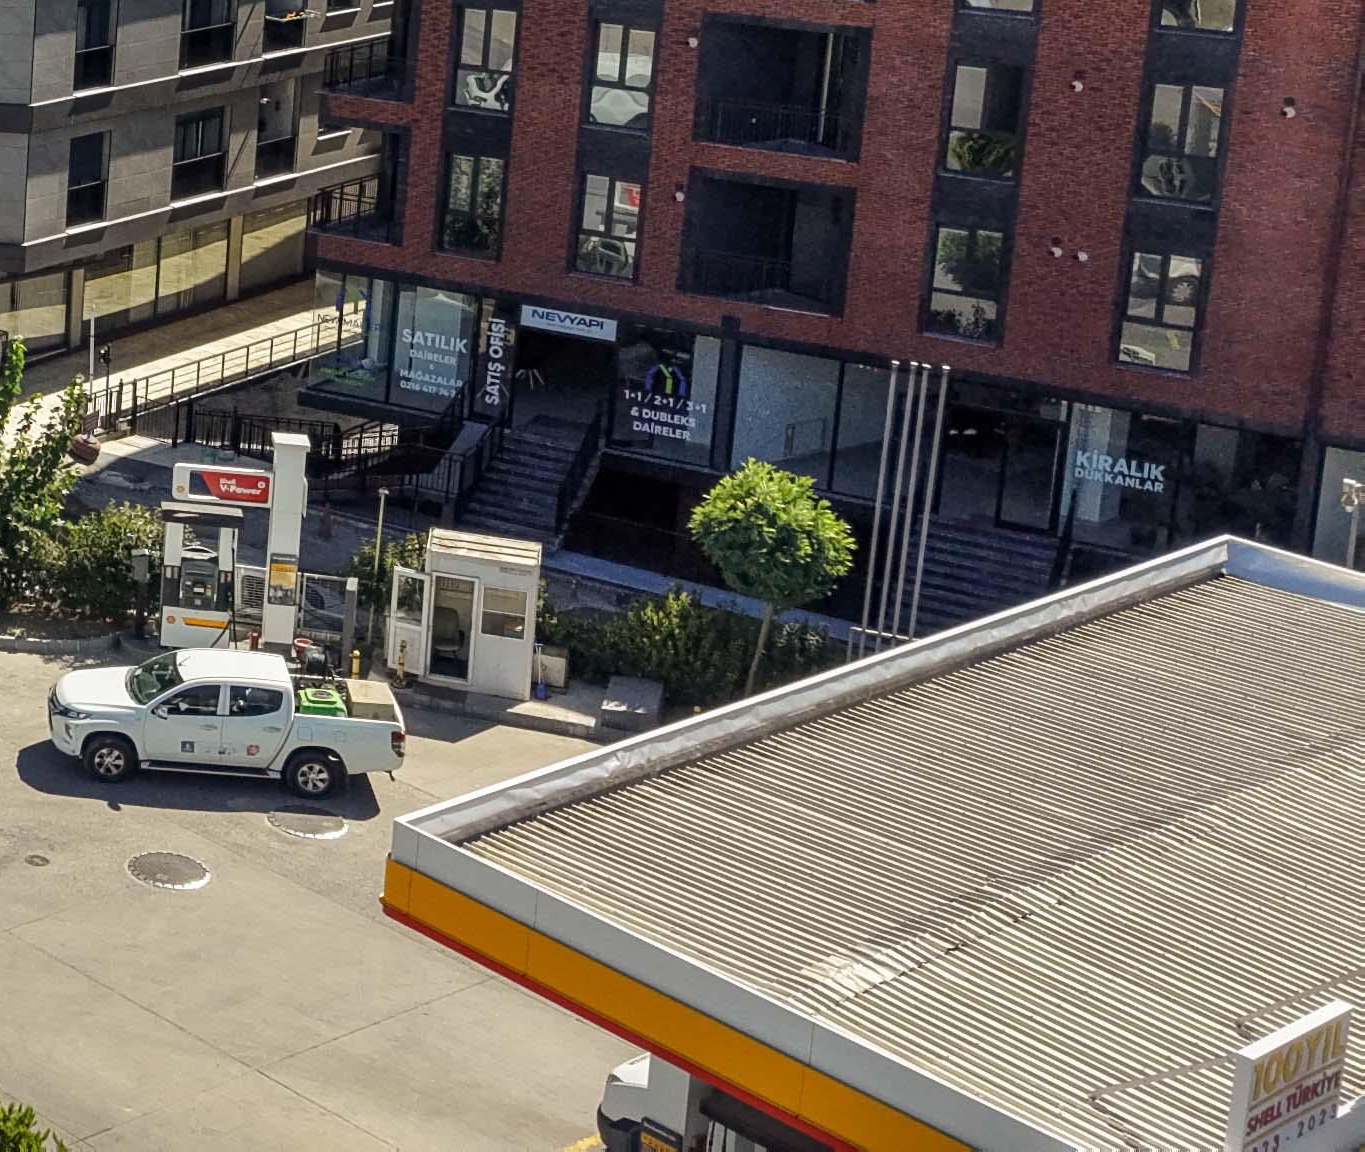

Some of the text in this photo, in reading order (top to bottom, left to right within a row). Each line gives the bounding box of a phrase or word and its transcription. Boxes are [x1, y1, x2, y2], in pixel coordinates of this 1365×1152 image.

[401, 328, 469, 354] SATILIK
[485, 317, 506, 405] SATIŞ OFİSİ
[630, 406, 696, 428] & DUBLEKS
[633, 420, 691, 441] DAİRELER
[1076, 449, 1166, 482] KİRALIK
[1245, 1069, 1342, 1137] SHELL TÜRKİYE
[1296, 1103, 1338, 1139] 2023
